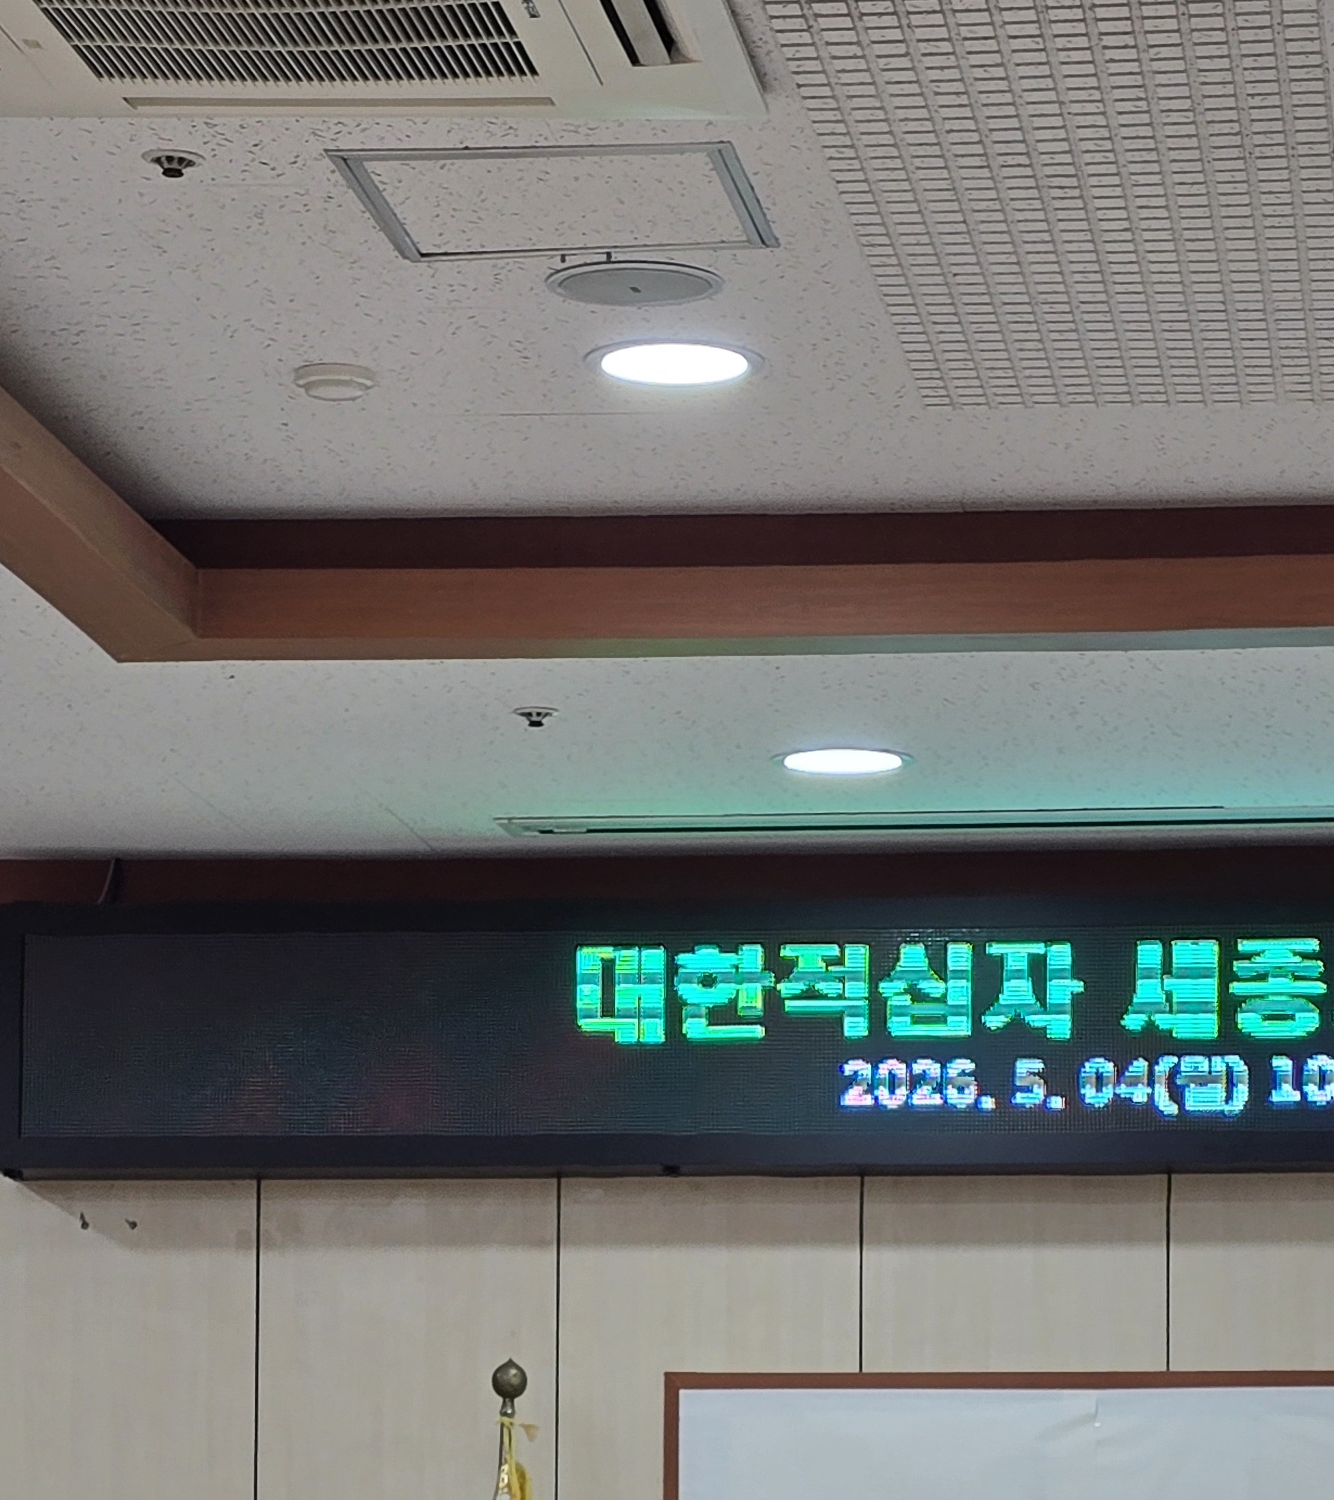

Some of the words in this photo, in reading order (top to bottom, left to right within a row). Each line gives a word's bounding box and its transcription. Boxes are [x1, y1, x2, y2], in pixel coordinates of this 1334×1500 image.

[576, 942, 1085, 1044] 대한적십자
[839, 1057, 996, 1110] 2026.
[1011, 1057, 1066, 1110] 5.
